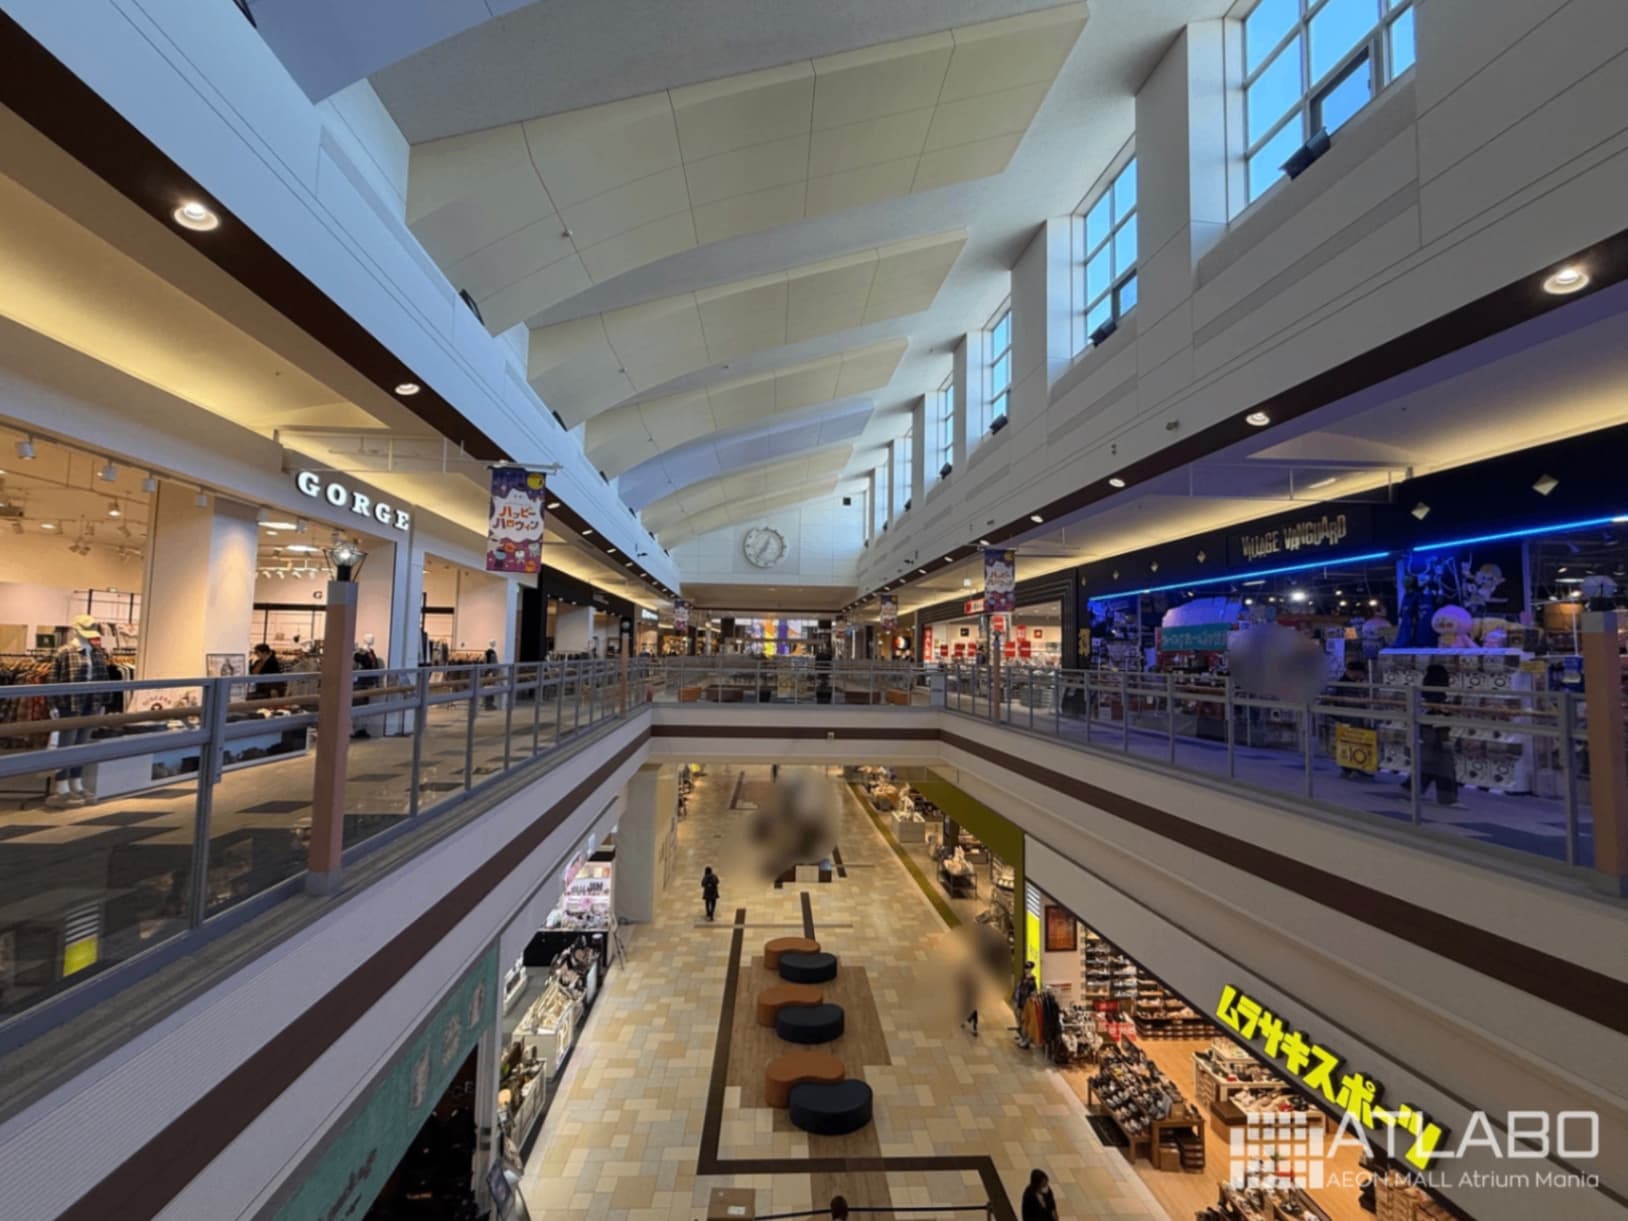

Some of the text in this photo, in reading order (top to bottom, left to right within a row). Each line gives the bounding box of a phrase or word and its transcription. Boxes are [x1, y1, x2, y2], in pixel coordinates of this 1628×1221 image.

[297, 471, 410, 531] GORGE
[492, 518, 539, 531] ハロウィン
[499, 505, 537, 519] ハッピー
[1241, 514, 1347, 562] VILLAGE VANGUARD
[1216, 984, 1443, 1170] ムラサキスポーツ
